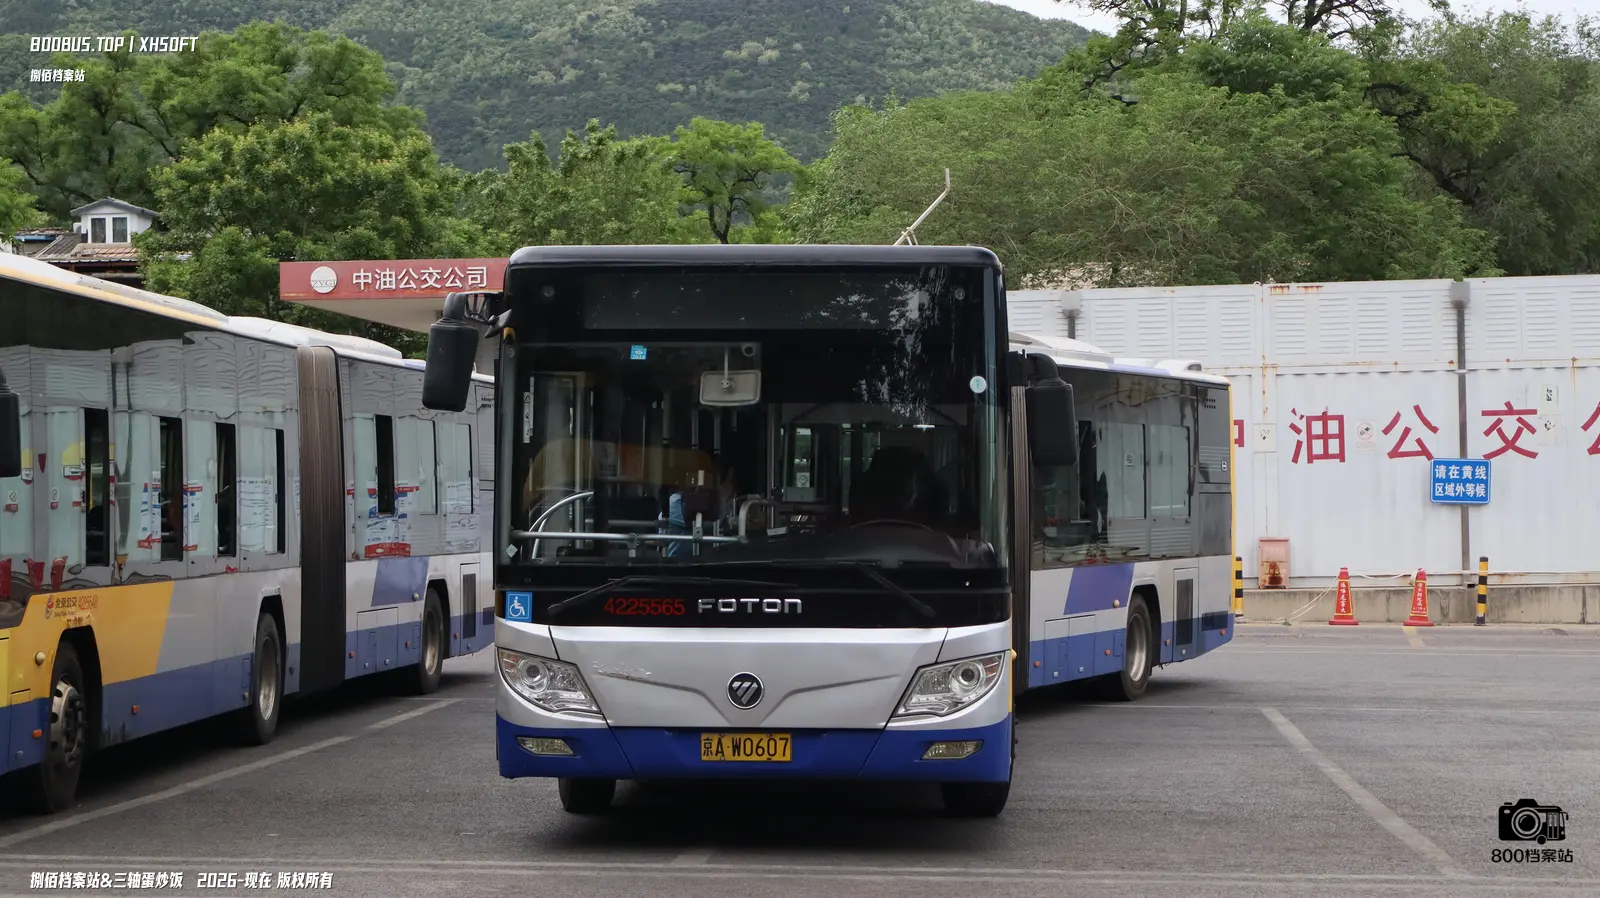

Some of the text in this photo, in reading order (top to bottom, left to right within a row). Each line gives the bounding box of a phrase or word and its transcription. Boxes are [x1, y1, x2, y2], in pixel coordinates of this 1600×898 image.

[352, 266, 487, 290] 中油公交公司
[1435, 465, 1487, 479] 请在黄线
[1435, 482, 1486, 497] 区域外等候
[55, 596, 77, 609] 北京公交
[603, 597, 802, 615] 4225565 FOTON
